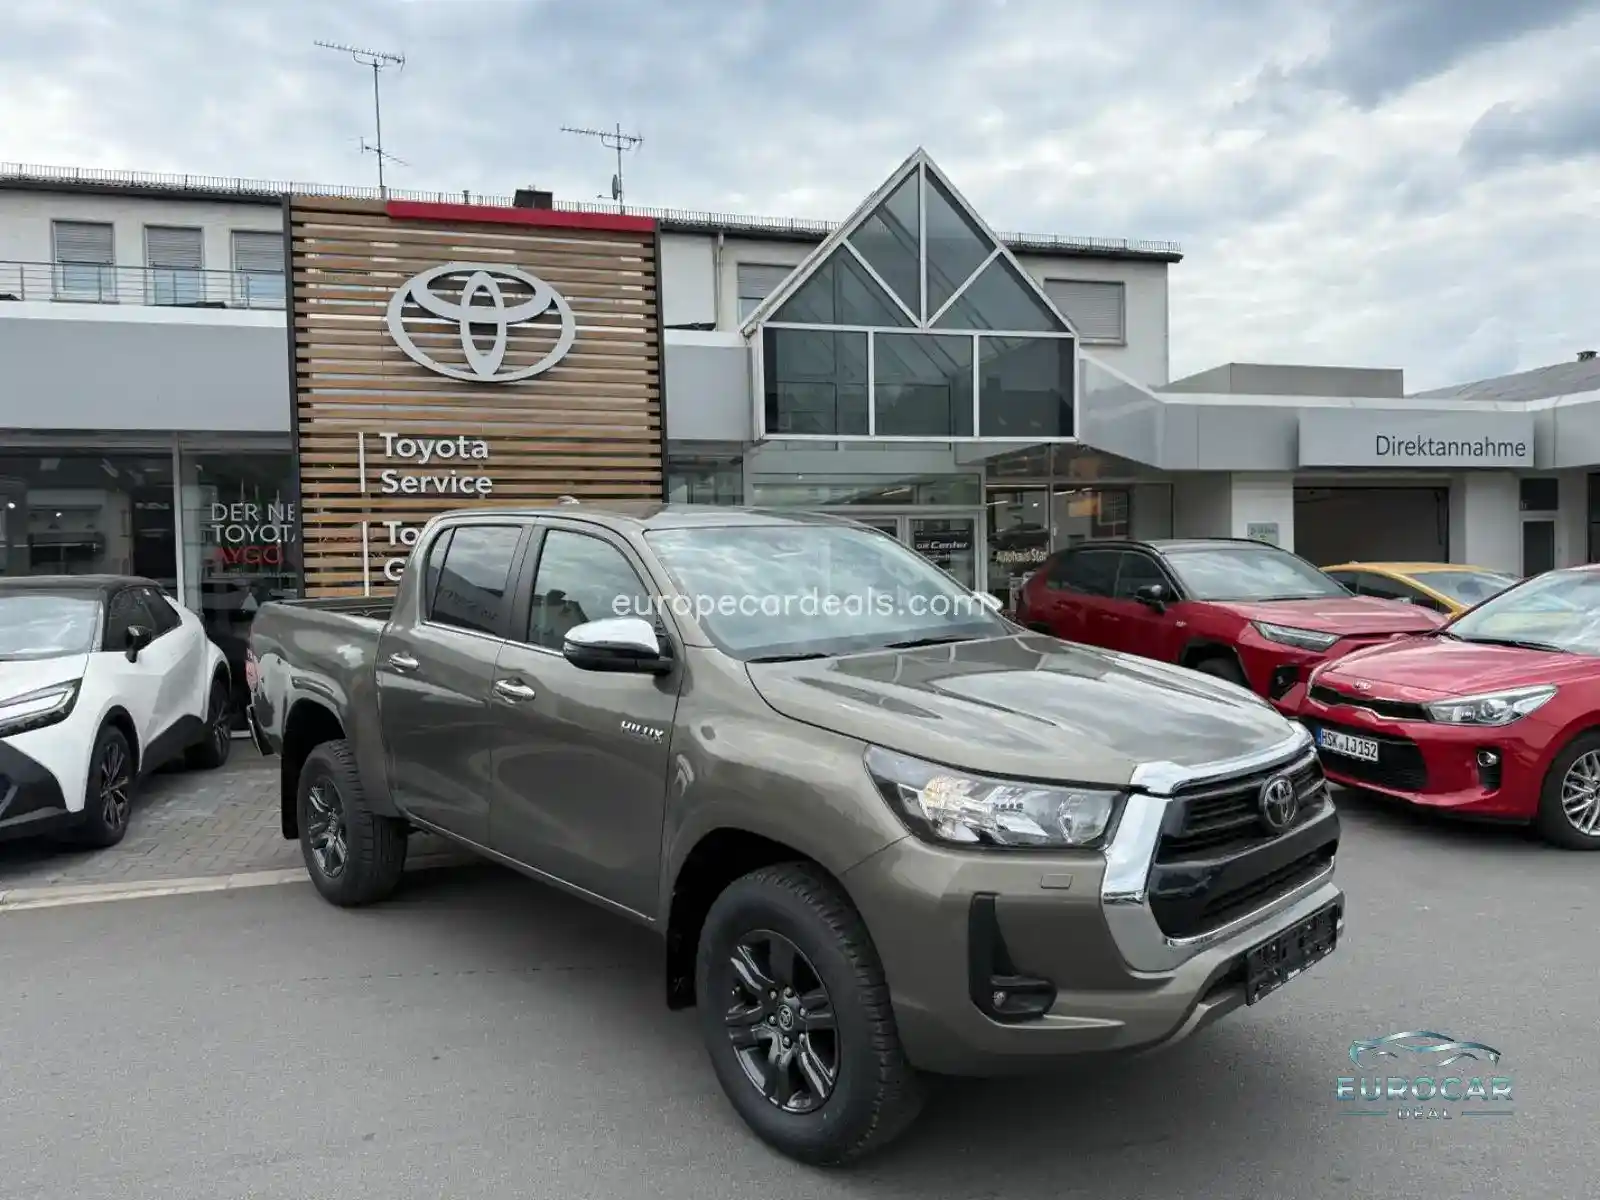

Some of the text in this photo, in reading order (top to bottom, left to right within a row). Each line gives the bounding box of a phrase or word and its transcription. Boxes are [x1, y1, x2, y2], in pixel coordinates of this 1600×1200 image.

[379, 432, 489, 464] Toyota
[1376, 434, 1526, 457] Direktannahme
[381, 469, 493, 494] Service
[211, 503, 260, 521] DER
[211, 524, 296, 542] TOYOT
[383, 521, 424, 546] To
[214, 545, 284, 564] AYGO
